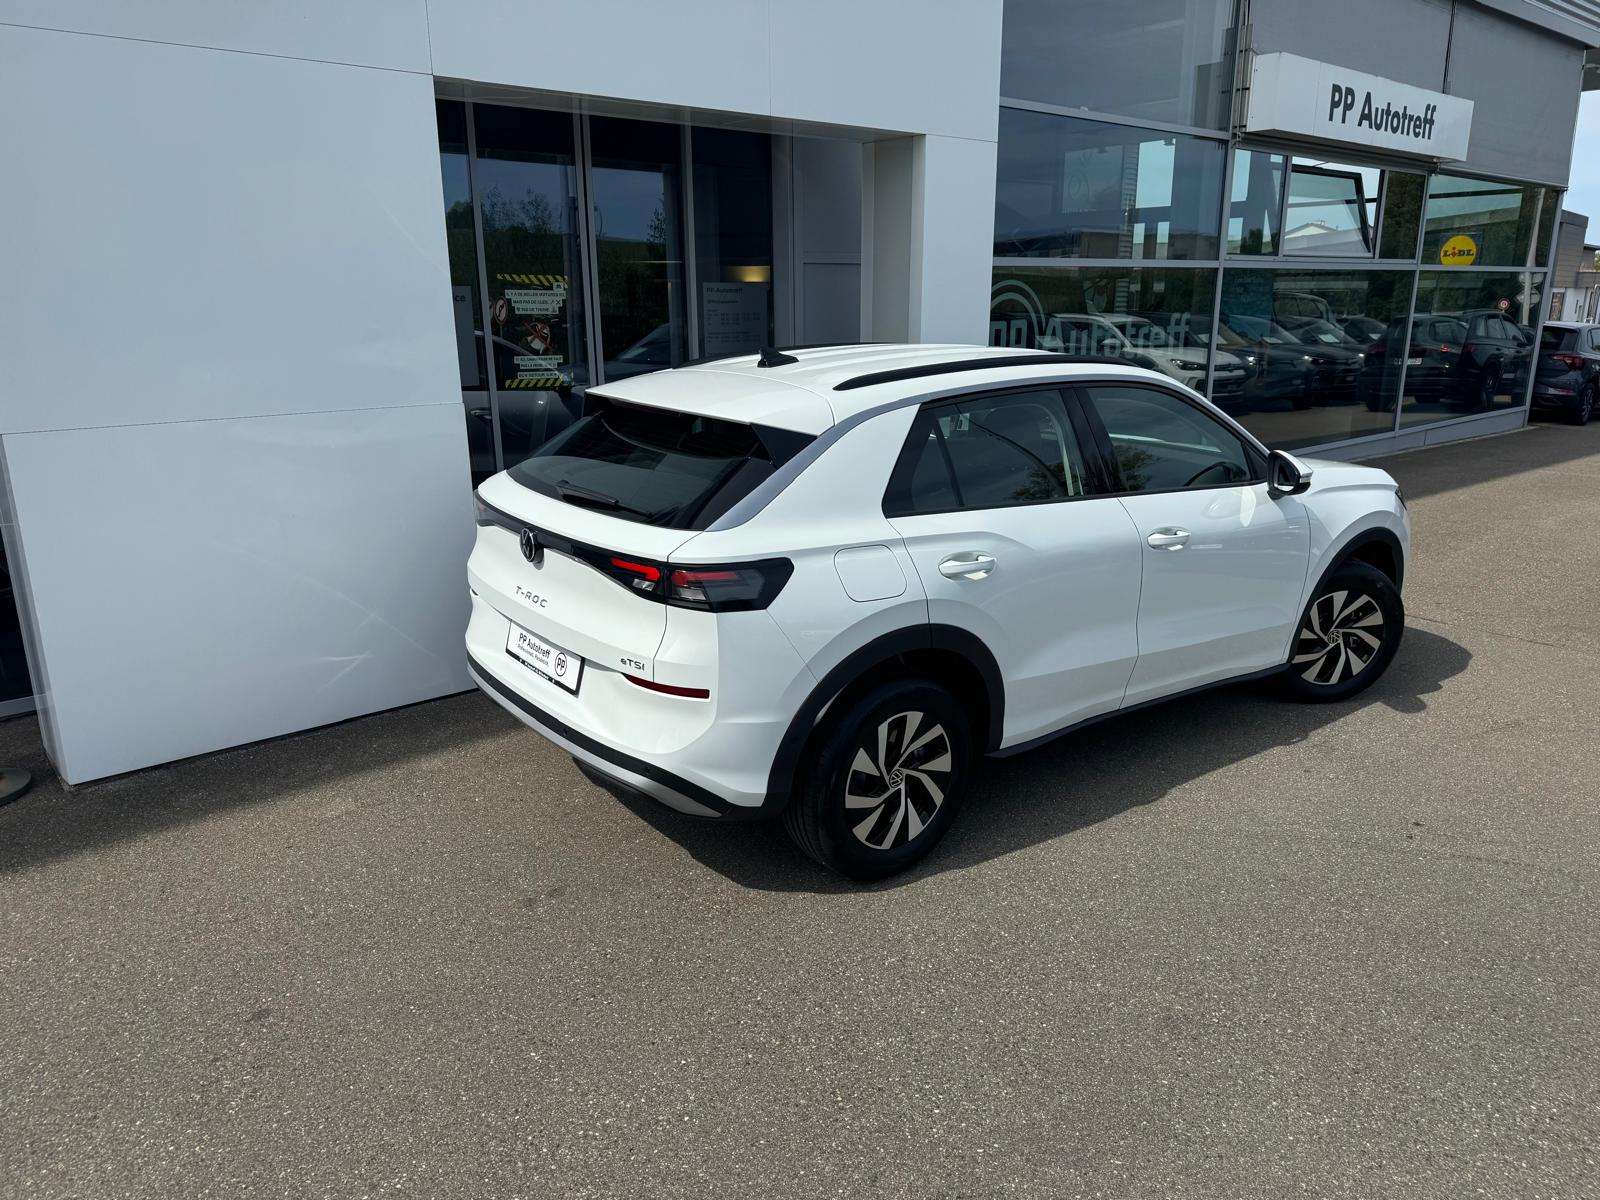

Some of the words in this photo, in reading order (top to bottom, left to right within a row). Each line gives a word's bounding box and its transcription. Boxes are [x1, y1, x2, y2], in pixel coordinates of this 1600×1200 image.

[1328, 83, 1355, 124] PP
[1357, 91, 1437, 140] Autotreff
[1044, 312, 1192, 359] Autotreff
[515, 586, 549, 608] T-ROC
[518, 632, 527, 644] PP
[527, 638, 551, 659] Autotreff
[556, 657, 566, 672] PP
[620, 657, 645, 672] eTSI
